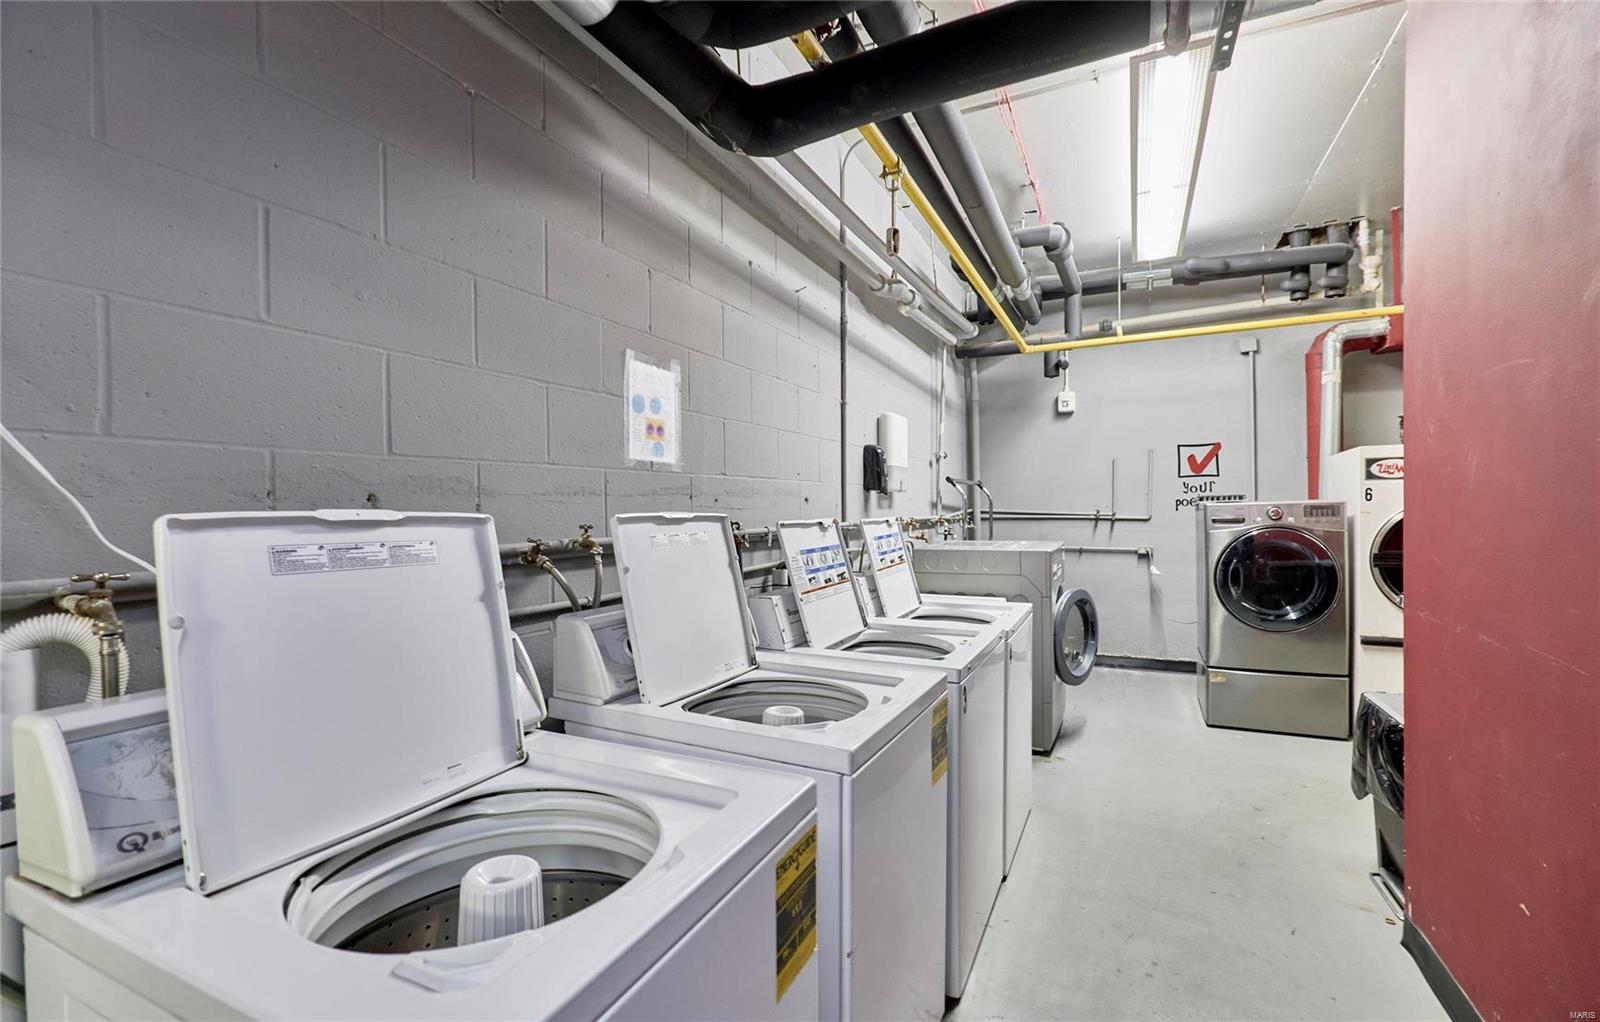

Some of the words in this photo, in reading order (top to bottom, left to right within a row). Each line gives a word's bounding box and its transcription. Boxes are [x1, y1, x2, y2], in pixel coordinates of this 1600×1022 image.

[1376, 463, 1404, 475] UniM
[1183, 481, 1216, 494] your
[1365, 487, 1373, 502] 6
